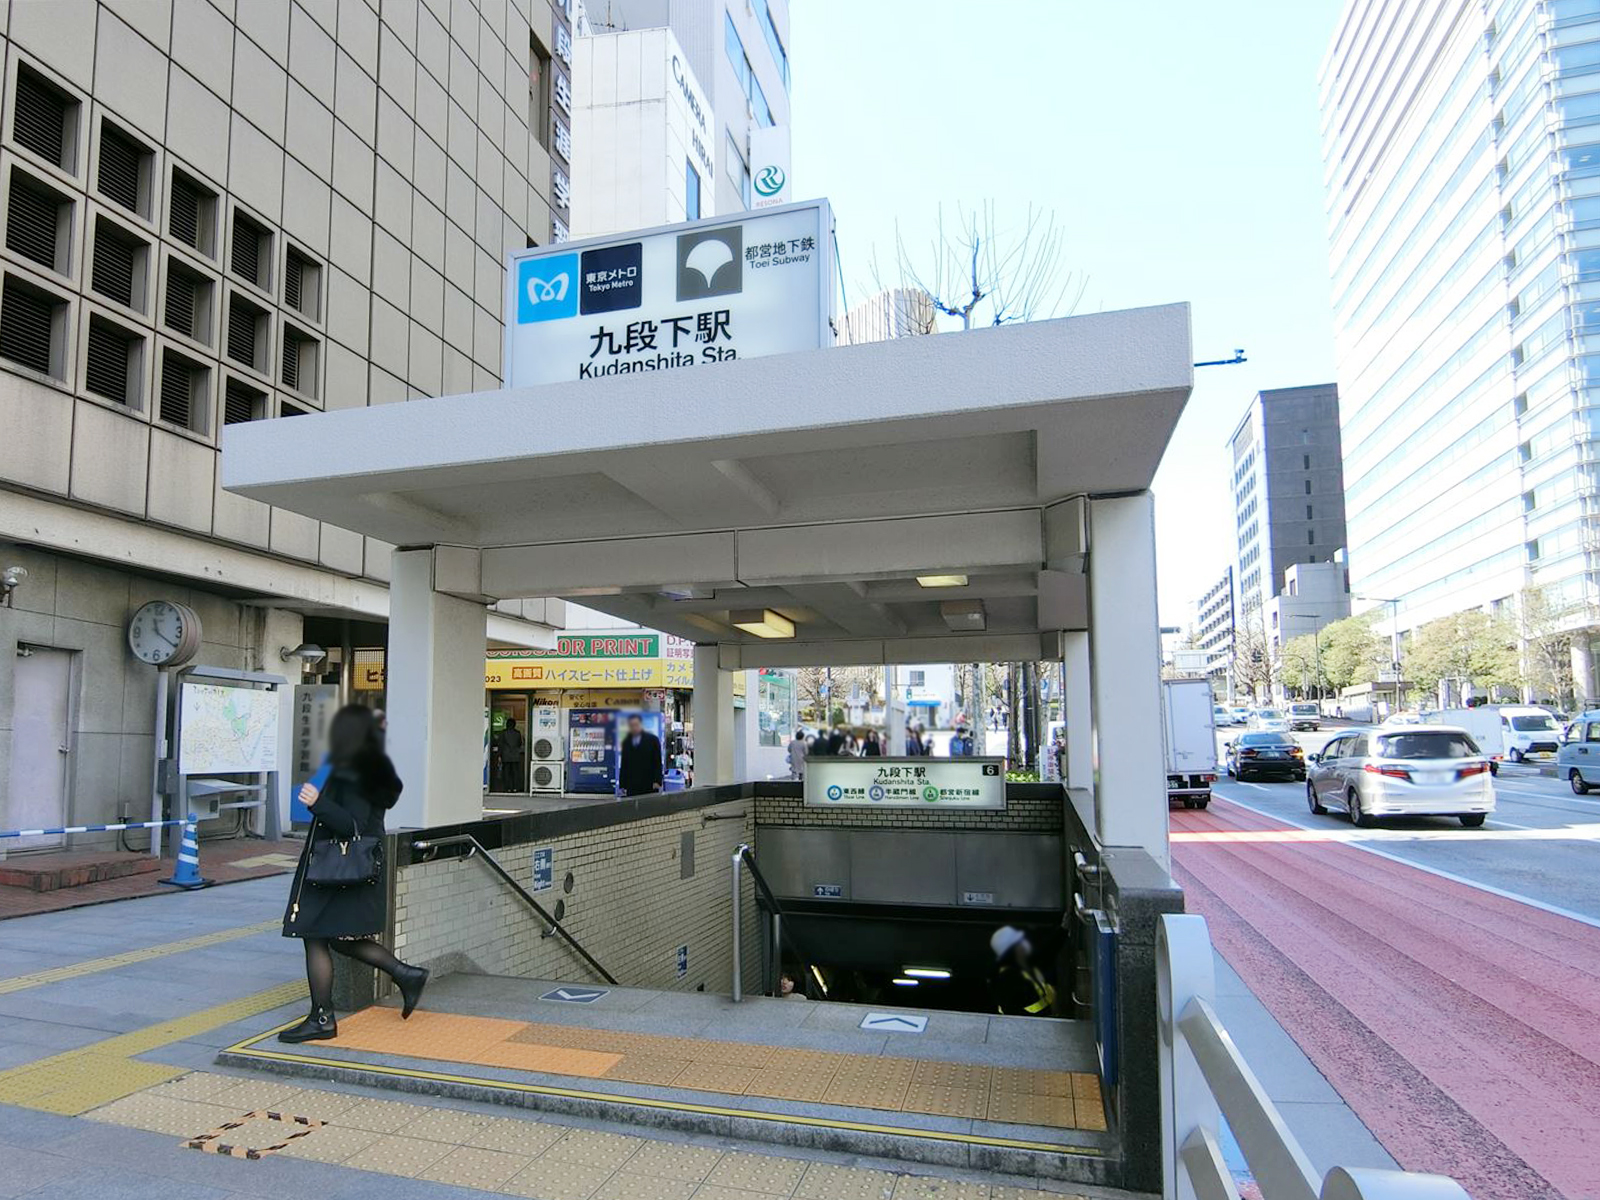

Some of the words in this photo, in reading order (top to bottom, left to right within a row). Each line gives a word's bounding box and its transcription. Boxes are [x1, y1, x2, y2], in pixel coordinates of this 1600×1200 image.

[672, 54, 707, 134] CAMERA
[691, 128, 713, 180] HIRAI
[755, 197, 784, 207] RESONA
[744, 236, 816, 261] 都営地下鉄
[750, 258, 770, 269] Toei
[772, 253, 811, 268] Subway
[585, 266, 637, 285] 東京メトロ
[588, 283, 611, 293] Tokyo
[611, 280, 634, 290] Metro
[589, 309, 732, 359] 九段下駅
[579, 351, 695, 380] Kudanshita
[175, 626, 182, 638] 3
[591, 638, 652, 656] PRINT
[152, 649, 160, 661] 6
[545, 668, 652, 682] ハイスピード仕上げ
[533, 697, 558, 707] Nikon
[604, 697, 640, 706] Canon
[877, 766, 926, 778] 九段下駅
[986, 766, 994, 775] 6
[917, 778, 932, 786] Sta.
